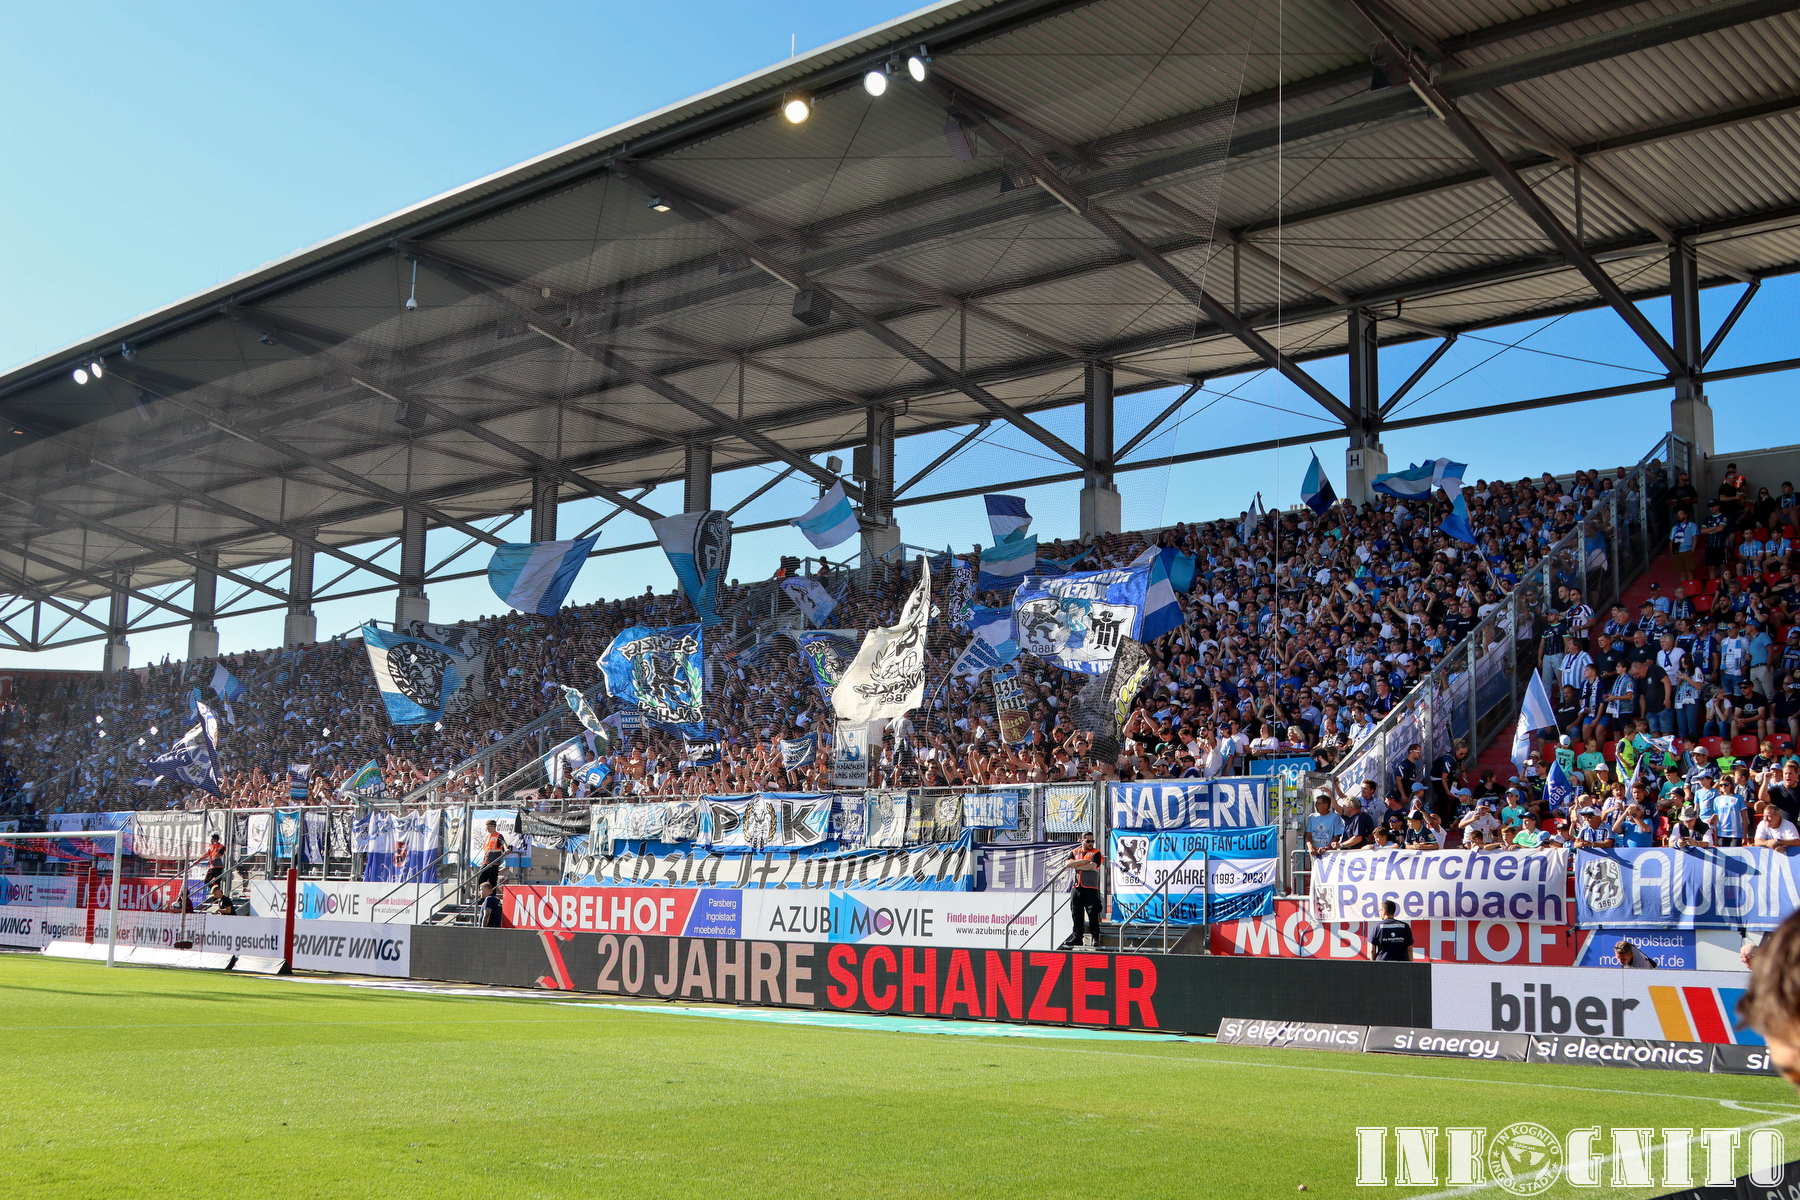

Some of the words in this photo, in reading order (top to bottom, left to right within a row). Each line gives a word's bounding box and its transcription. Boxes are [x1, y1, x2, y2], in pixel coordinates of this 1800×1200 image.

[1350, 453, 1360, 467] H
[1558, 757, 1567, 769] 4
[1112, 783, 1266, 829] HADERN
[1158, 836, 1178, 852] TSV
[1182, 836, 1209, 852] 1860
[1211, 833, 1268, 852] FAN-CLUB
[1154, 869, 1169, 885] 30
[1171, 869, 1205, 885] JAHRE
[1315, 850, 1549, 884] Vierkirchen
[1121, 876, 1140, 884] 1860
[313, 894, 360, 915] MOVIE
[708, 898, 737, 910] Parsberg
[0, 917, 33, 935] WINGS
[706, 911, 737, 923] Ingolstadt
[768, 905, 839, 934] AZUBI
[849, 906, 934, 937] MOVIE
[946, 912, 967, 924] Finde
[968, 913, 990, 924] deine
[693, 925, 737, 936] moebelhof.de
[234, 933, 279, 951] gesucht!
[292, 933, 347, 957] PRIVATE
[348, 937, 404, 962] WINGS
[596, 933, 646, 994] 20
[653, 937, 815, 1006] JAHRE
[826, 943, 1160, 1028] SCHANZER
[1491, 981, 1641, 1037] biber
[1224, 1019, 1245, 1038] si
[1246, 1020, 1360, 1045] electronics
[1393, 1030, 1416, 1050] si
[1418, 1034, 1500, 1059] energy
[1535, 1037, 1560, 1058] si
[1564, 1037, 1704, 1066] electronics
[1746, 1049, 1771, 1070] si
